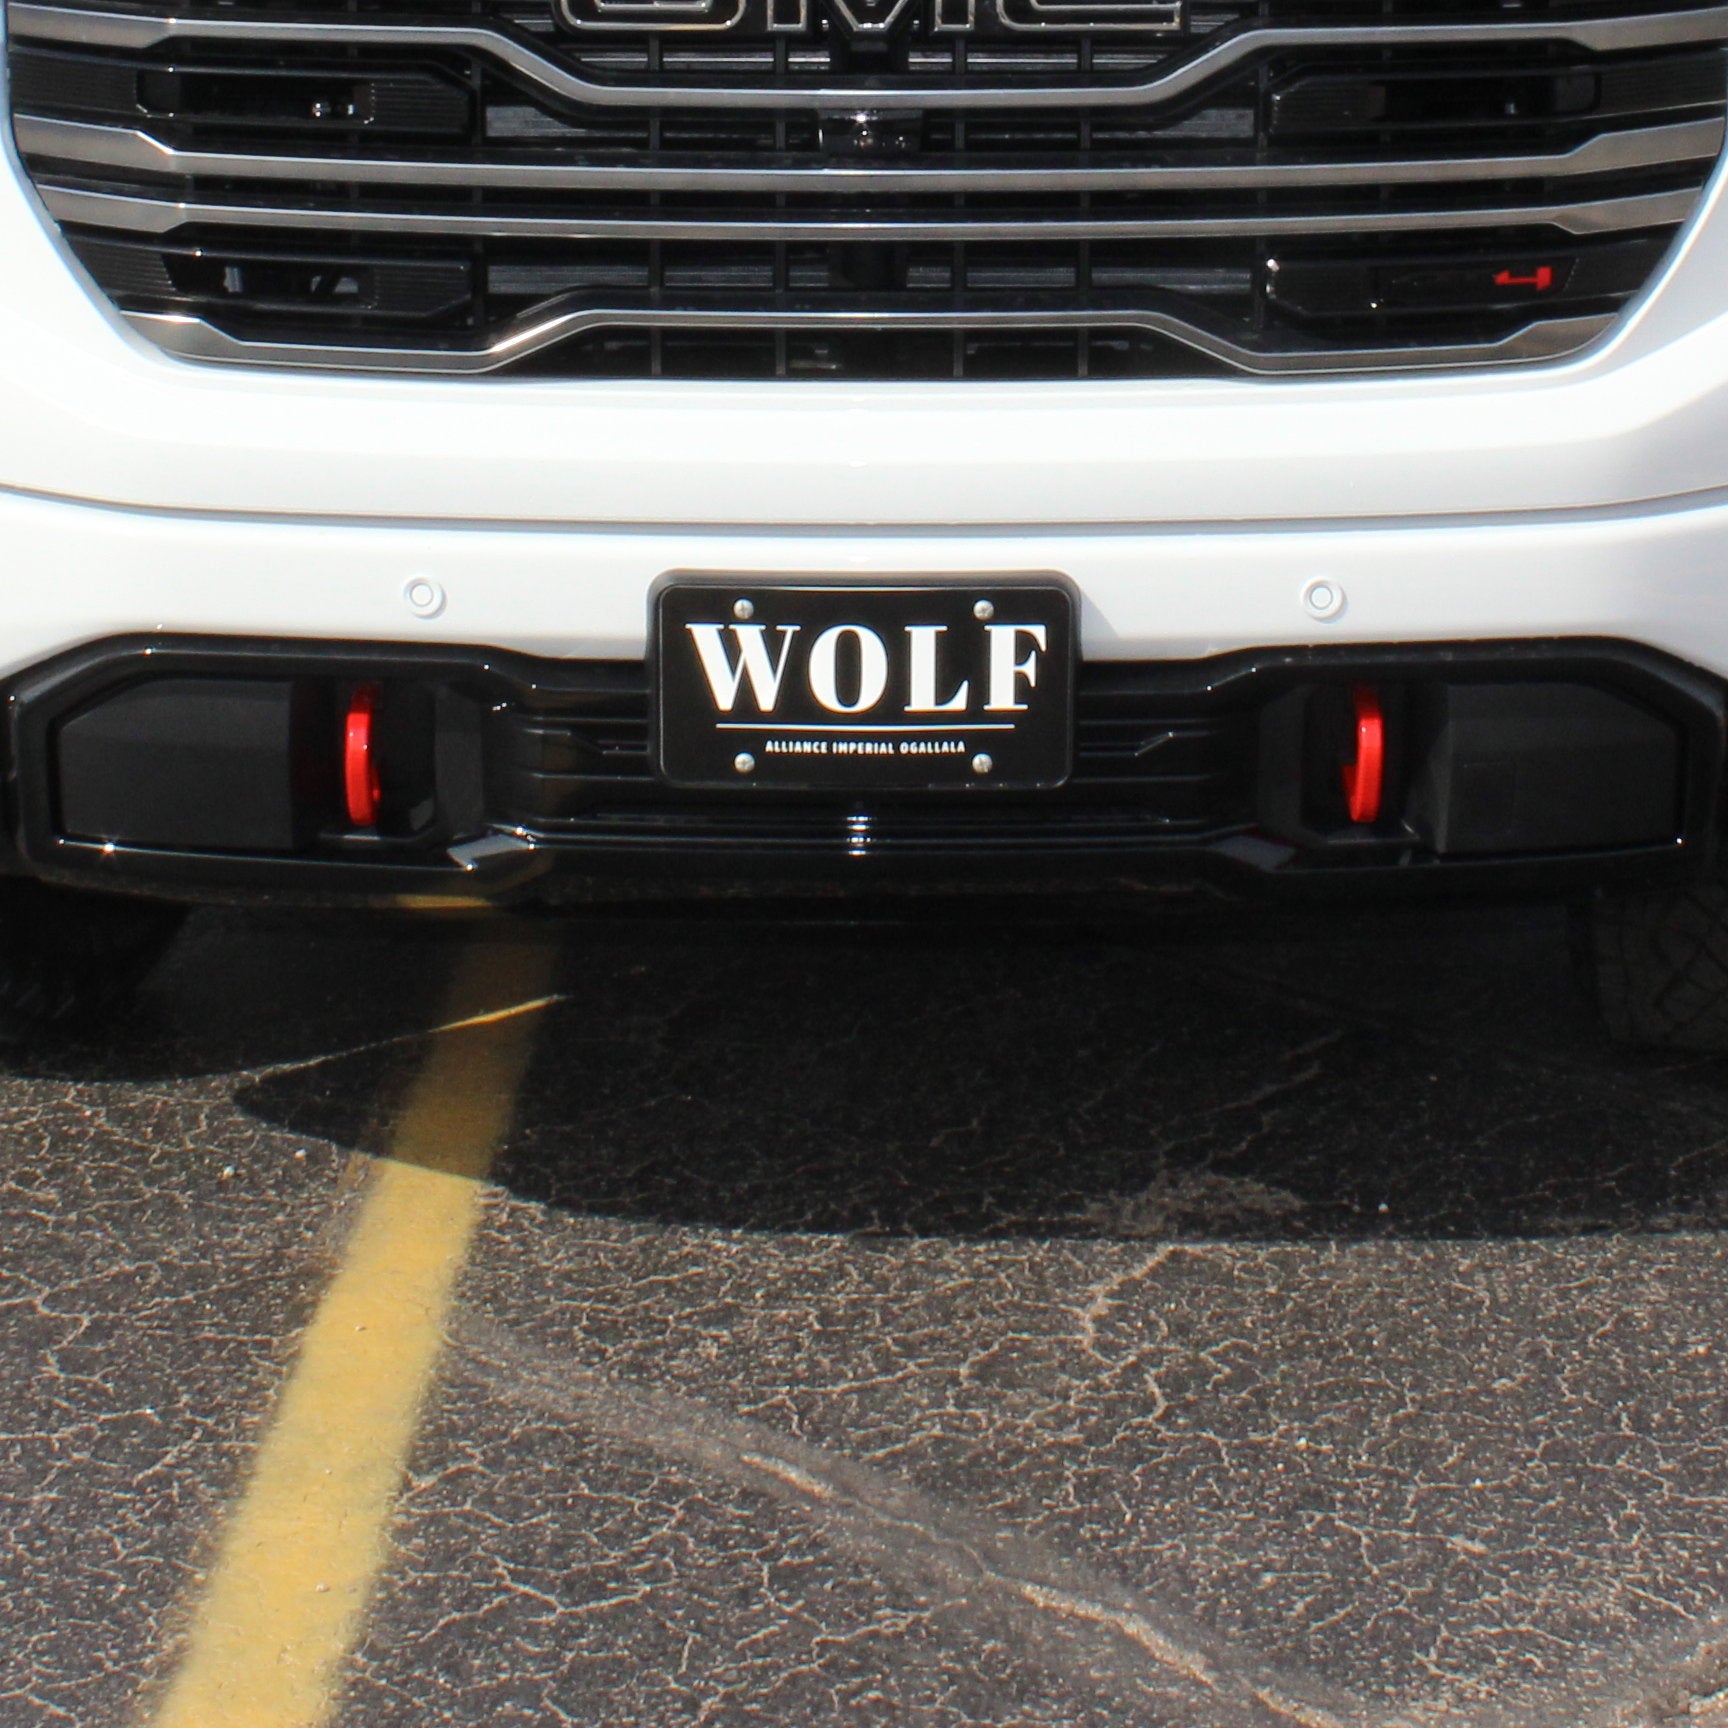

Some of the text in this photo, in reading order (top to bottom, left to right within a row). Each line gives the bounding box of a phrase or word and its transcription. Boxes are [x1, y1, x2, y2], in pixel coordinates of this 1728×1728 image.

[685, 623, 1048, 713] WOLF
[765, 740, 966, 755] ALLIANCE IMPERIAL OGALLALA
